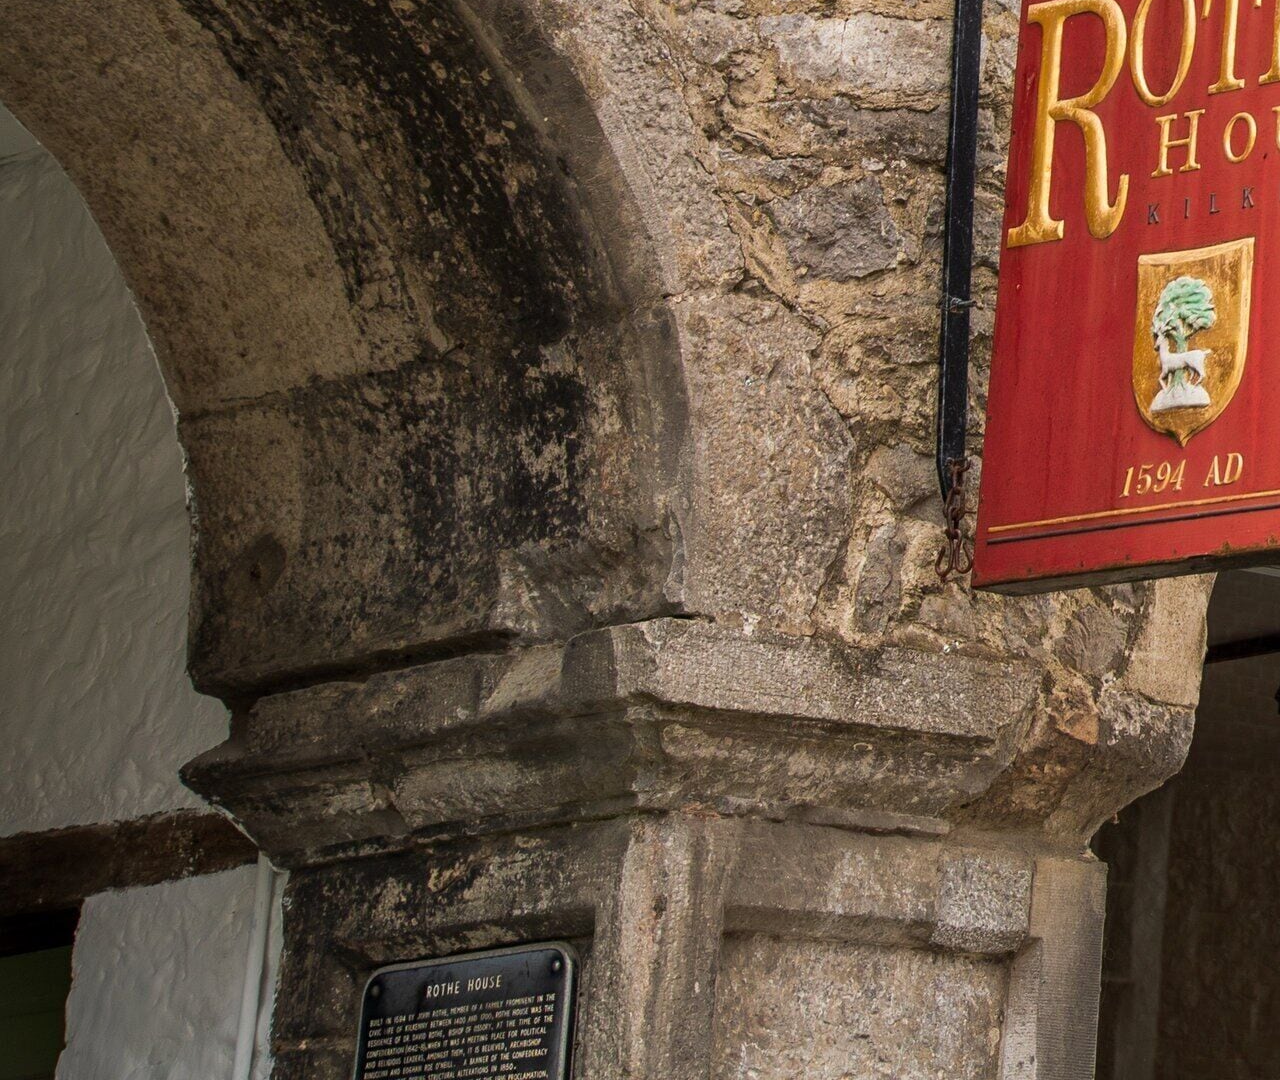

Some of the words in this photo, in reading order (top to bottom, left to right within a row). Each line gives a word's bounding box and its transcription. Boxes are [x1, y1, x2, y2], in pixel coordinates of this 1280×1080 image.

[1118, 459, 1187, 498] 1594
[1202, 452, 1244, 487] AD
[426, 981, 461, 998] ROTHE
[467, 975, 502, 992] HOUSE
[396, 1026, 403, 1034] OF
[430, 1019, 452, 1029] BETWEEN
[468, 1015, 478, 1023] AND
[512, 1007, 529, 1017] HOUSE
[531, 1005, 542, 1014] WAS
[544, 1004, 554, 1012] THE
[450, 1006, 469, 1015] MEMBER
[471, 1004, 478, 1012] OF
[505, 996, 535, 1007] PROMINENT
[537, 995, 544, 1003] IN
[546, 993, 556, 1001] THE
[395, 1036, 402, 1044] OF
[465, 1026, 472, 1034] OF
[506, 1020, 516, 1028] THE
[518, 1018, 531, 1026] TIME
[533, 1016, 541, 1024] OF
[544, 1014, 554, 1022] THE
[443, 1040, 448, 1048] IT
[450, 1038, 460, 1047] WAS
[462, 1037, 466, 1045] A
[467, 1034, 489, 1044] MEETING
[491, 1032, 506, 1041] PLACE
[508, 1030, 518, 1038] FOR
[520, 1026, 547, 1036] POLITICAL
[365, 1061, 376, 1070] AND
[467, 1047, 473, 1055] IT
[474, 1046, 480, 1054] IS
[481, 1042, 508, 1053] BELIEVED,
[510, 1037, 542, 1049] ARCHBISHOP
[390, 1068, 401, 1077] AND
[463, 1058, 467, 1066] A
[469, 1055, 489, 1065] BANNER
[491, 1054, 498, 1062] OF
[500, 1052, 510, 1061] THE
[512, 1047, 549, 1059] CONFEDERACY
[490, 1065, 498, 1073] IN
